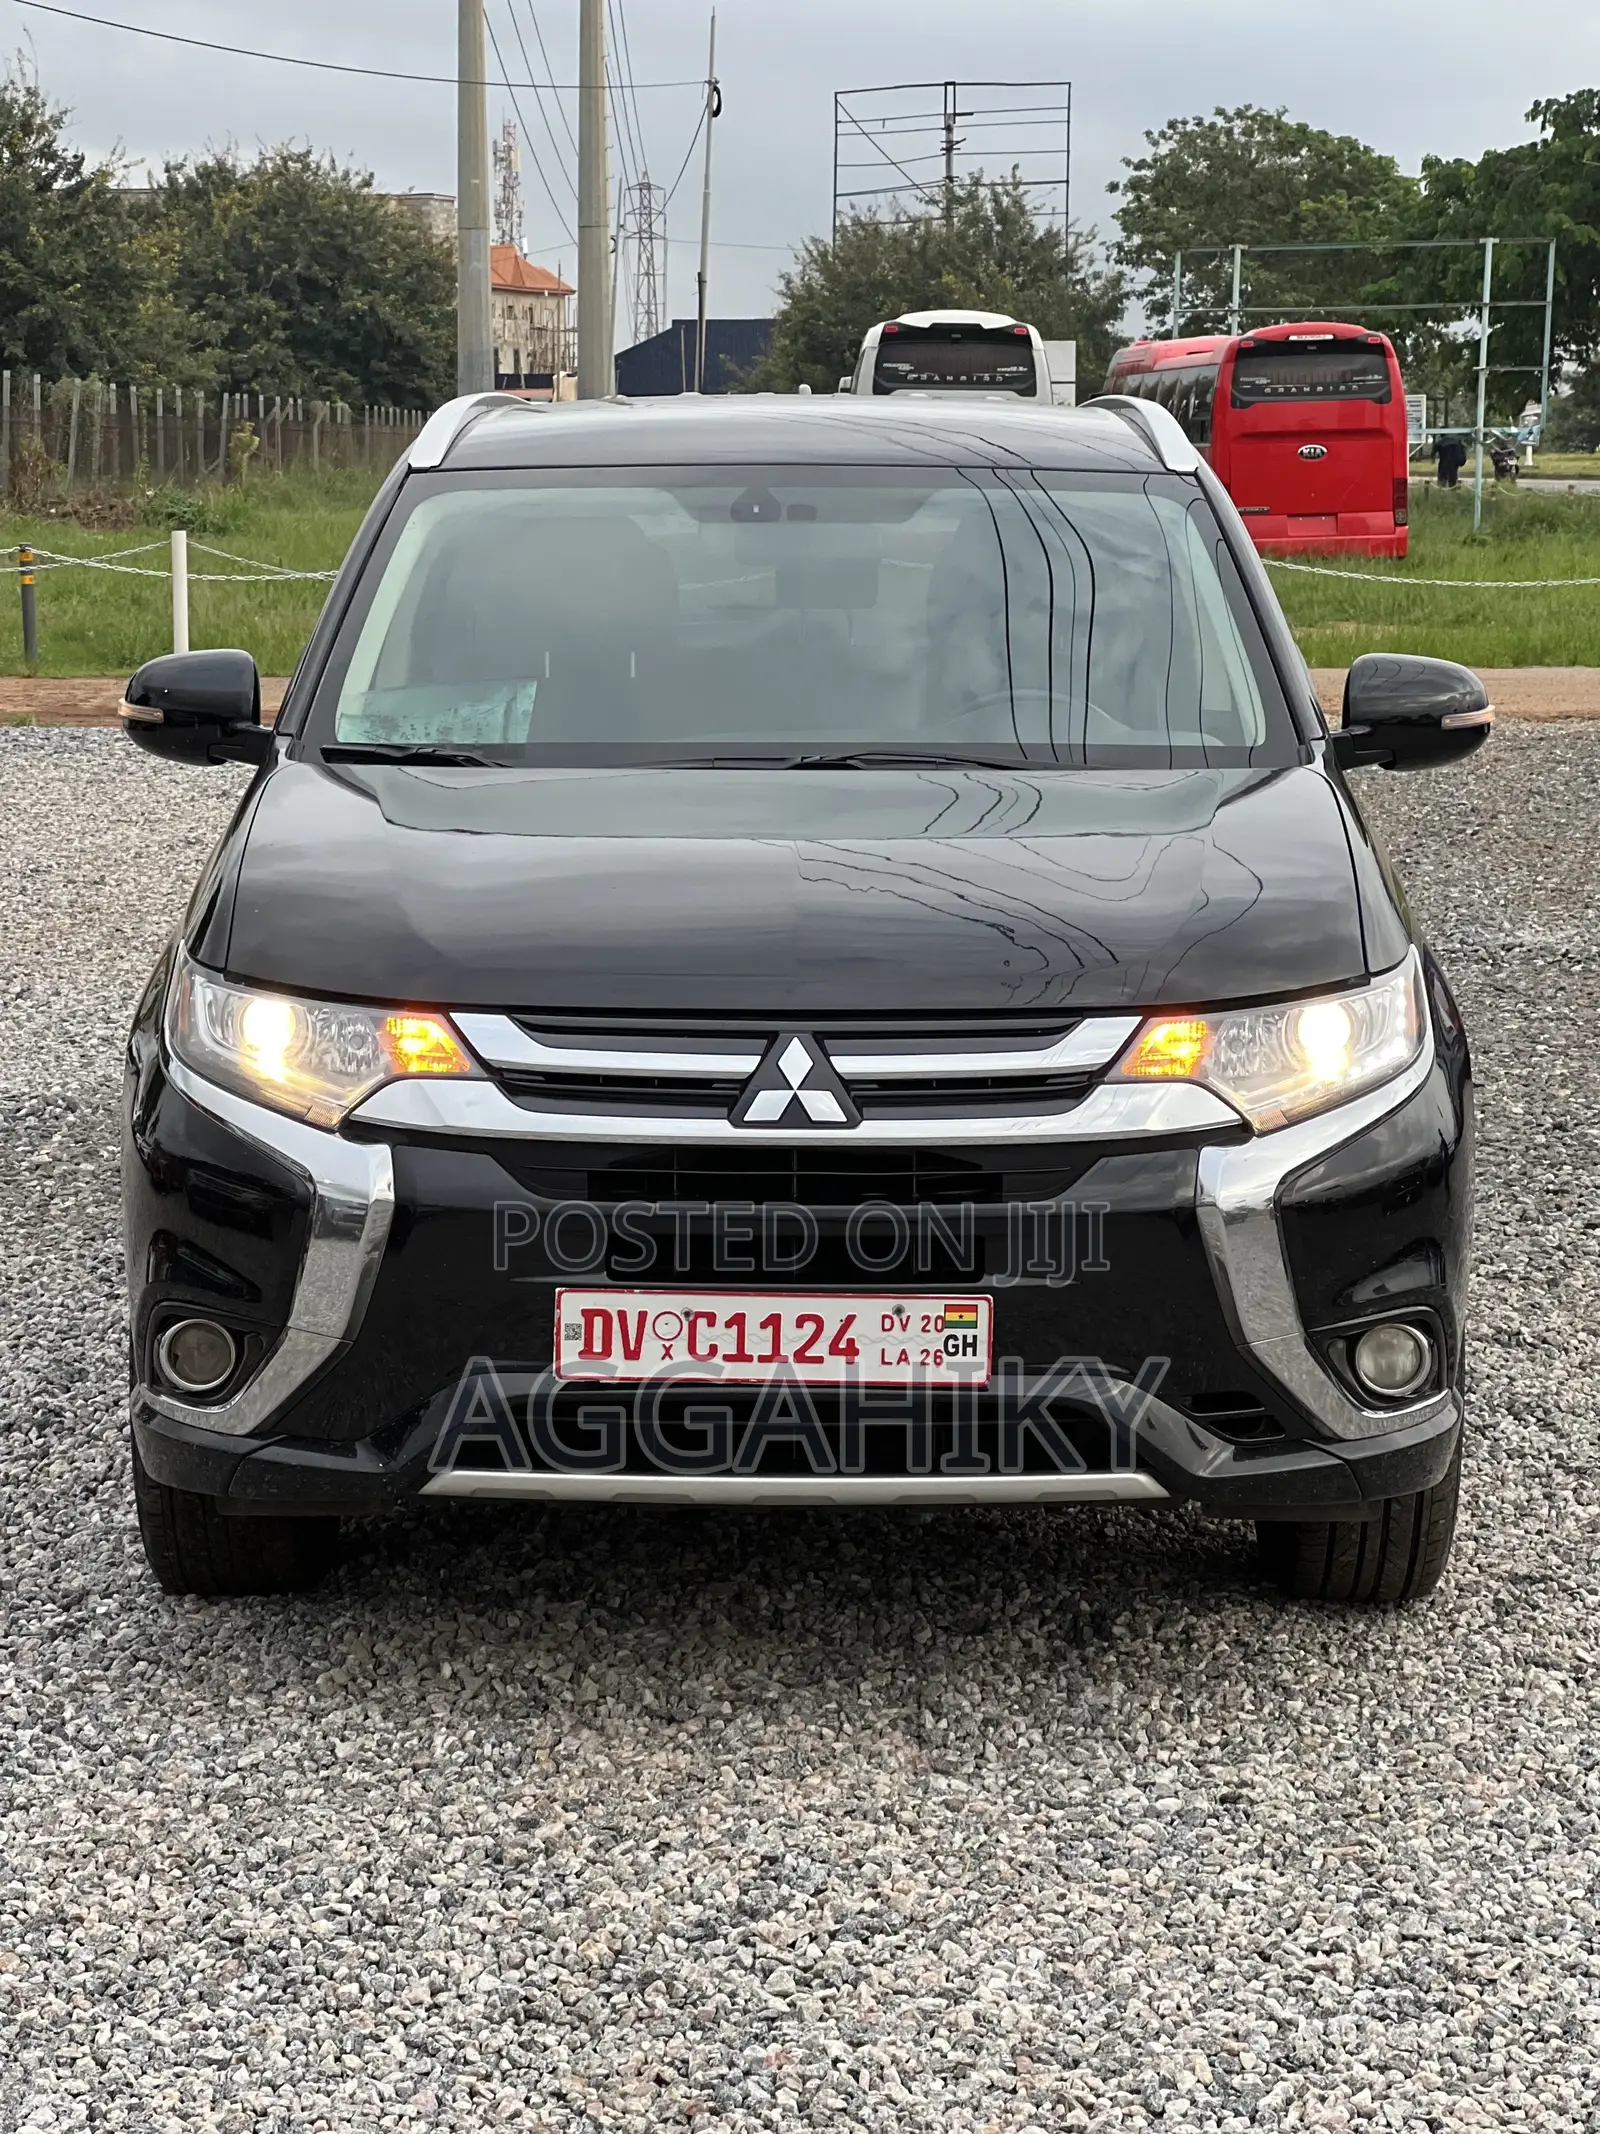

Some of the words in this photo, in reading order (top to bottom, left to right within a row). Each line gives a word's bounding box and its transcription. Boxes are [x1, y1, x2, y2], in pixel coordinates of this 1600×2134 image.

[1302, 447, 1323, 458] KIA
[881, 1313, 912, 1333] DV
[920, 1314, 945, 1333] 20
[578, 1308, 649, 1361] DV
[687, 1310, 860, 1365] C1124
[942, 1333, 978, 1357] GH
[880, 1347, 911, 1366] LA
[920, 1348, 944, 1367] 26
